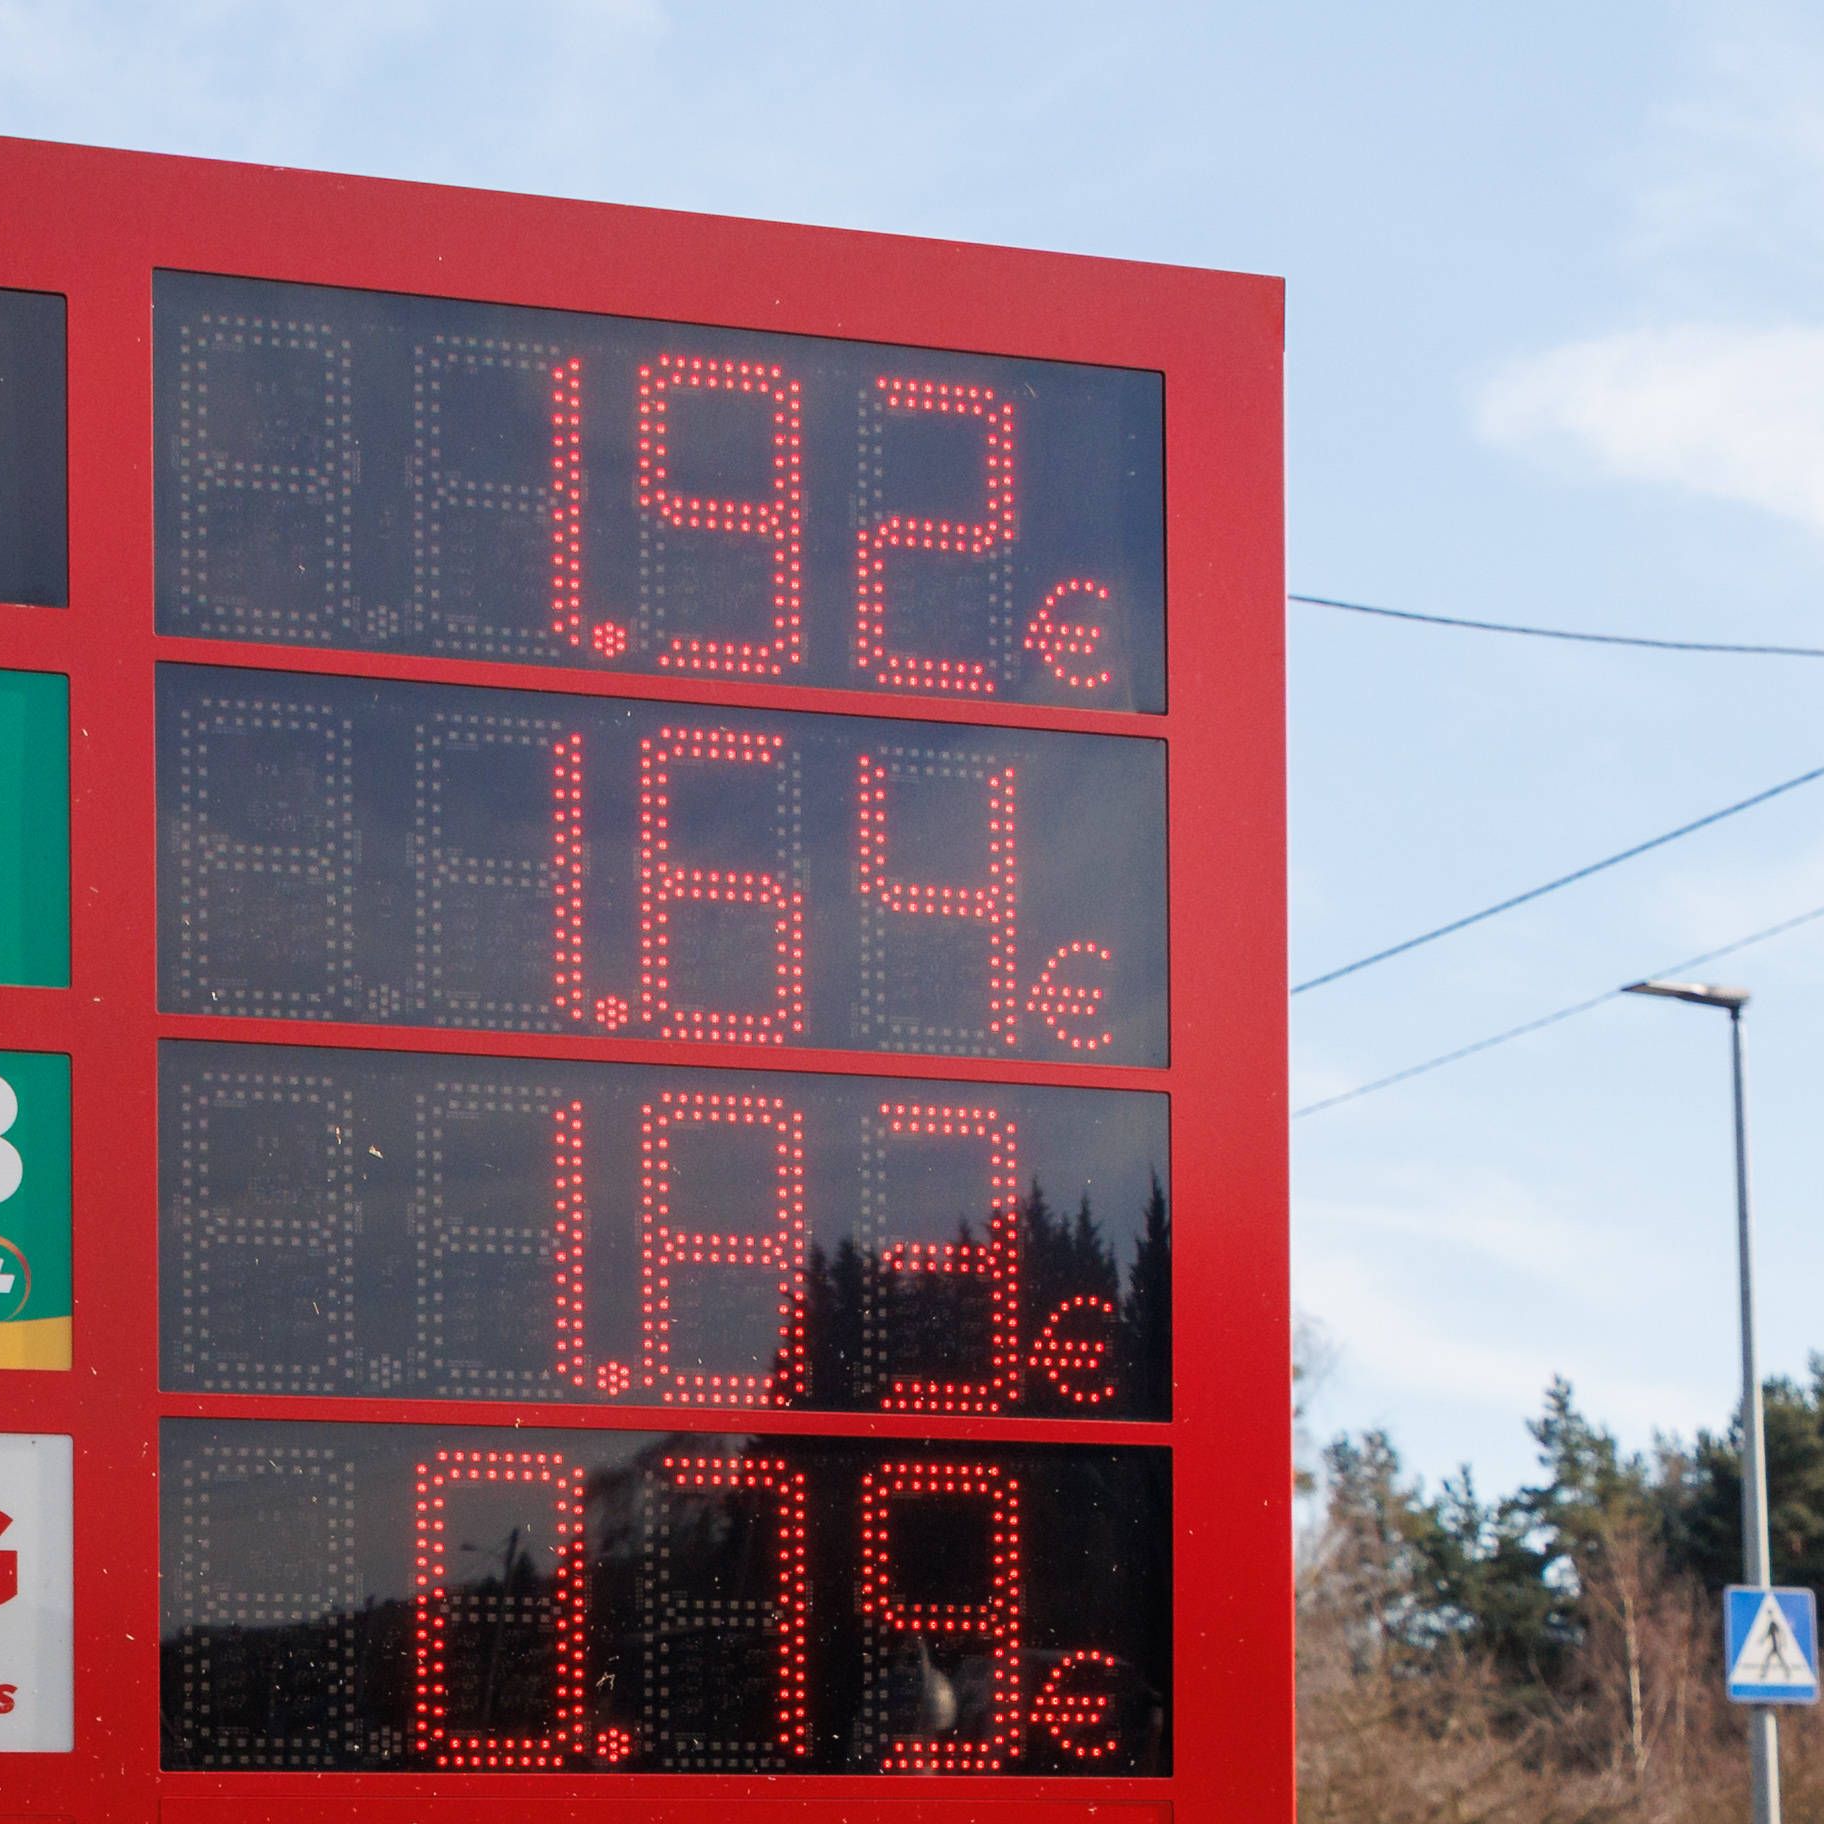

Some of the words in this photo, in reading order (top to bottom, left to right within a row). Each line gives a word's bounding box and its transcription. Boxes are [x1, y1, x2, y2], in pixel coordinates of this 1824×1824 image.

[550, 354, 1017, 690] 1.92
[1024, 578, 1113, 688] €
[551, 726, 1021, 1047] 1.64
[1026, 941, 1114, 1051] €
[553, 1091, 1018, 1412] 1.83
[1028, 1296, 1116, 1403] €
[416, 1450, 1020, 1770] 0.79
[1029, 1650, 1118, 1758] €
